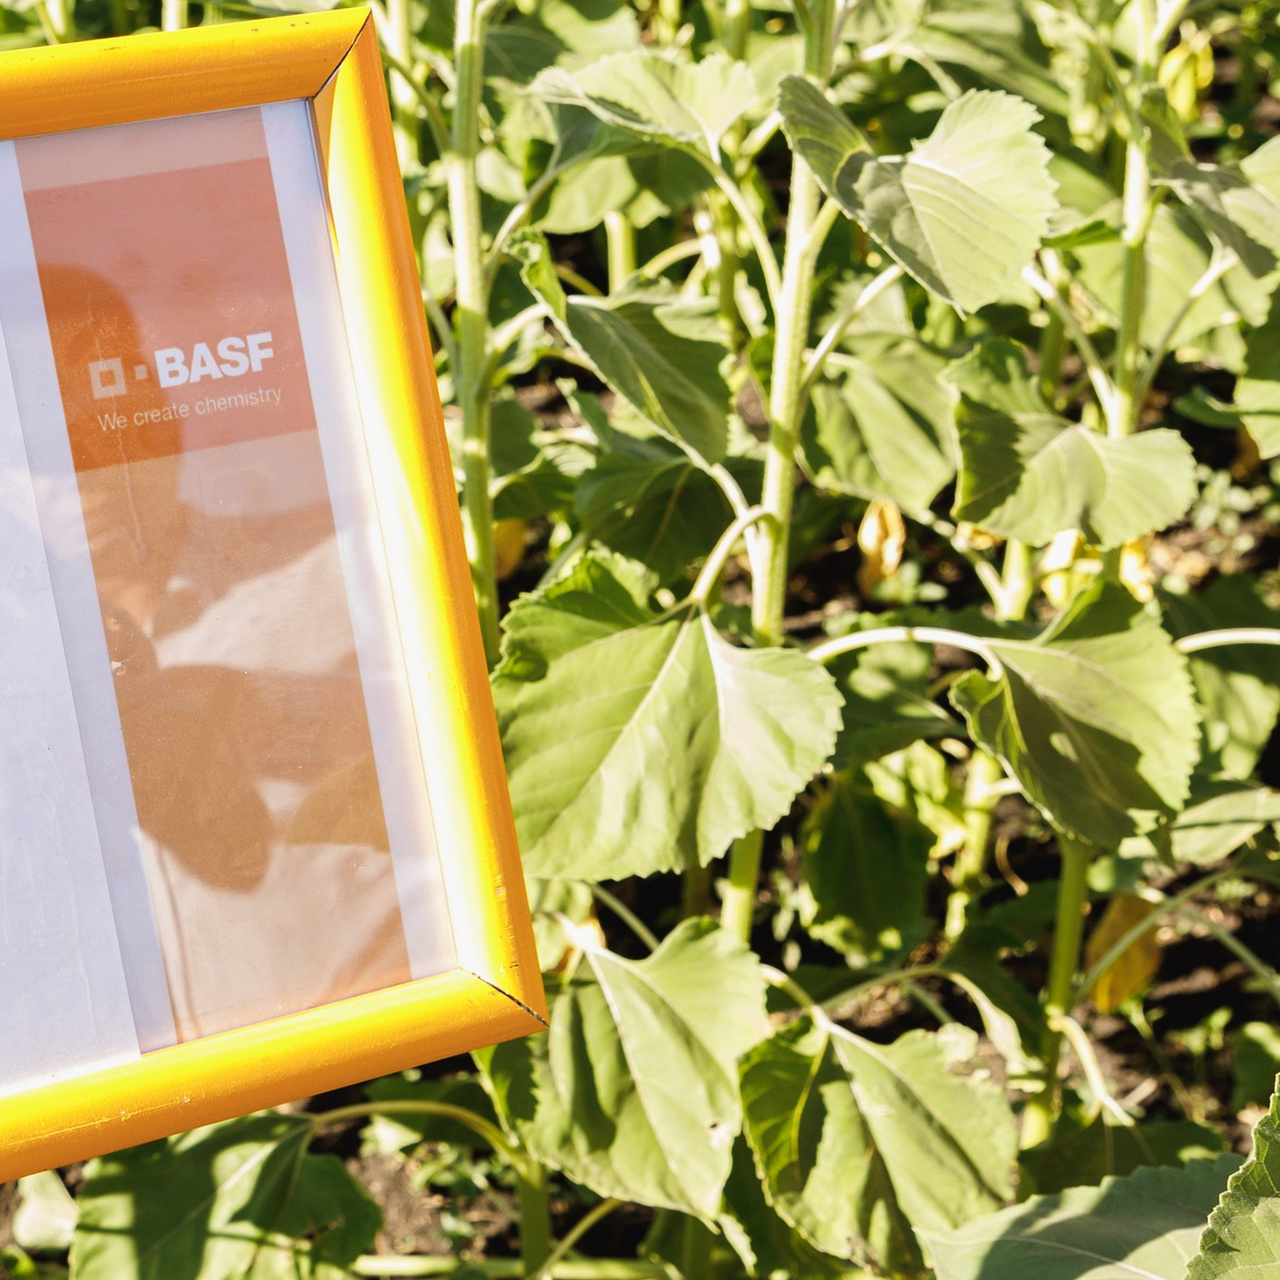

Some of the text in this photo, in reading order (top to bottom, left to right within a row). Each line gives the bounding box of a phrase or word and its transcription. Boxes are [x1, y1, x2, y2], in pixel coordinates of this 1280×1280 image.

[154, 332, 274, 388] BASF
[97, 388, 282, 431] We create chemistry
